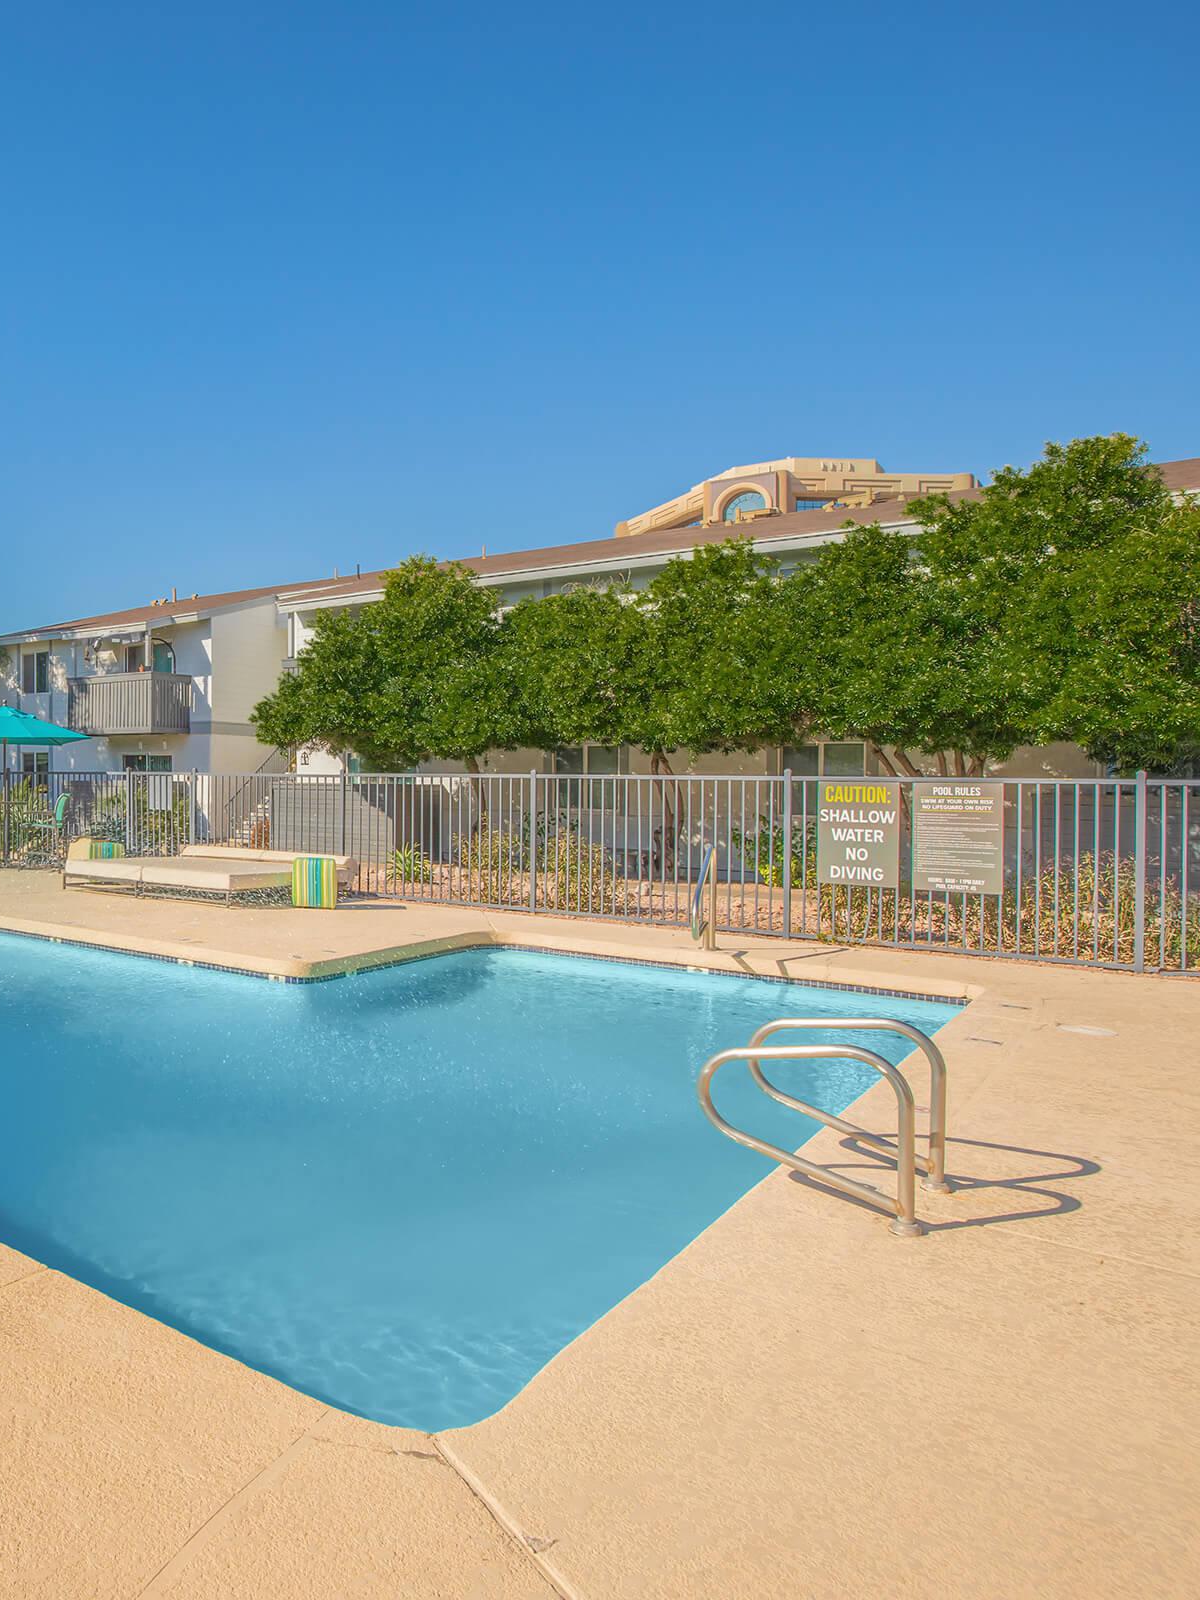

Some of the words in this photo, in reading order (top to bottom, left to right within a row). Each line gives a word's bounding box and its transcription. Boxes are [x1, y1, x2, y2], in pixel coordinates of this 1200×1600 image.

[825, 785, 891, 804] CAUTION:
[932, 787, 953, 796] POOL
[955, 787, 981, 796] RULES
[820, 809, 896, 824] SHALLOW
[831, 828, 884, 843] WATER
[845, 847, 868, 861] NO
[830, 864, 884, 881] DIVING
